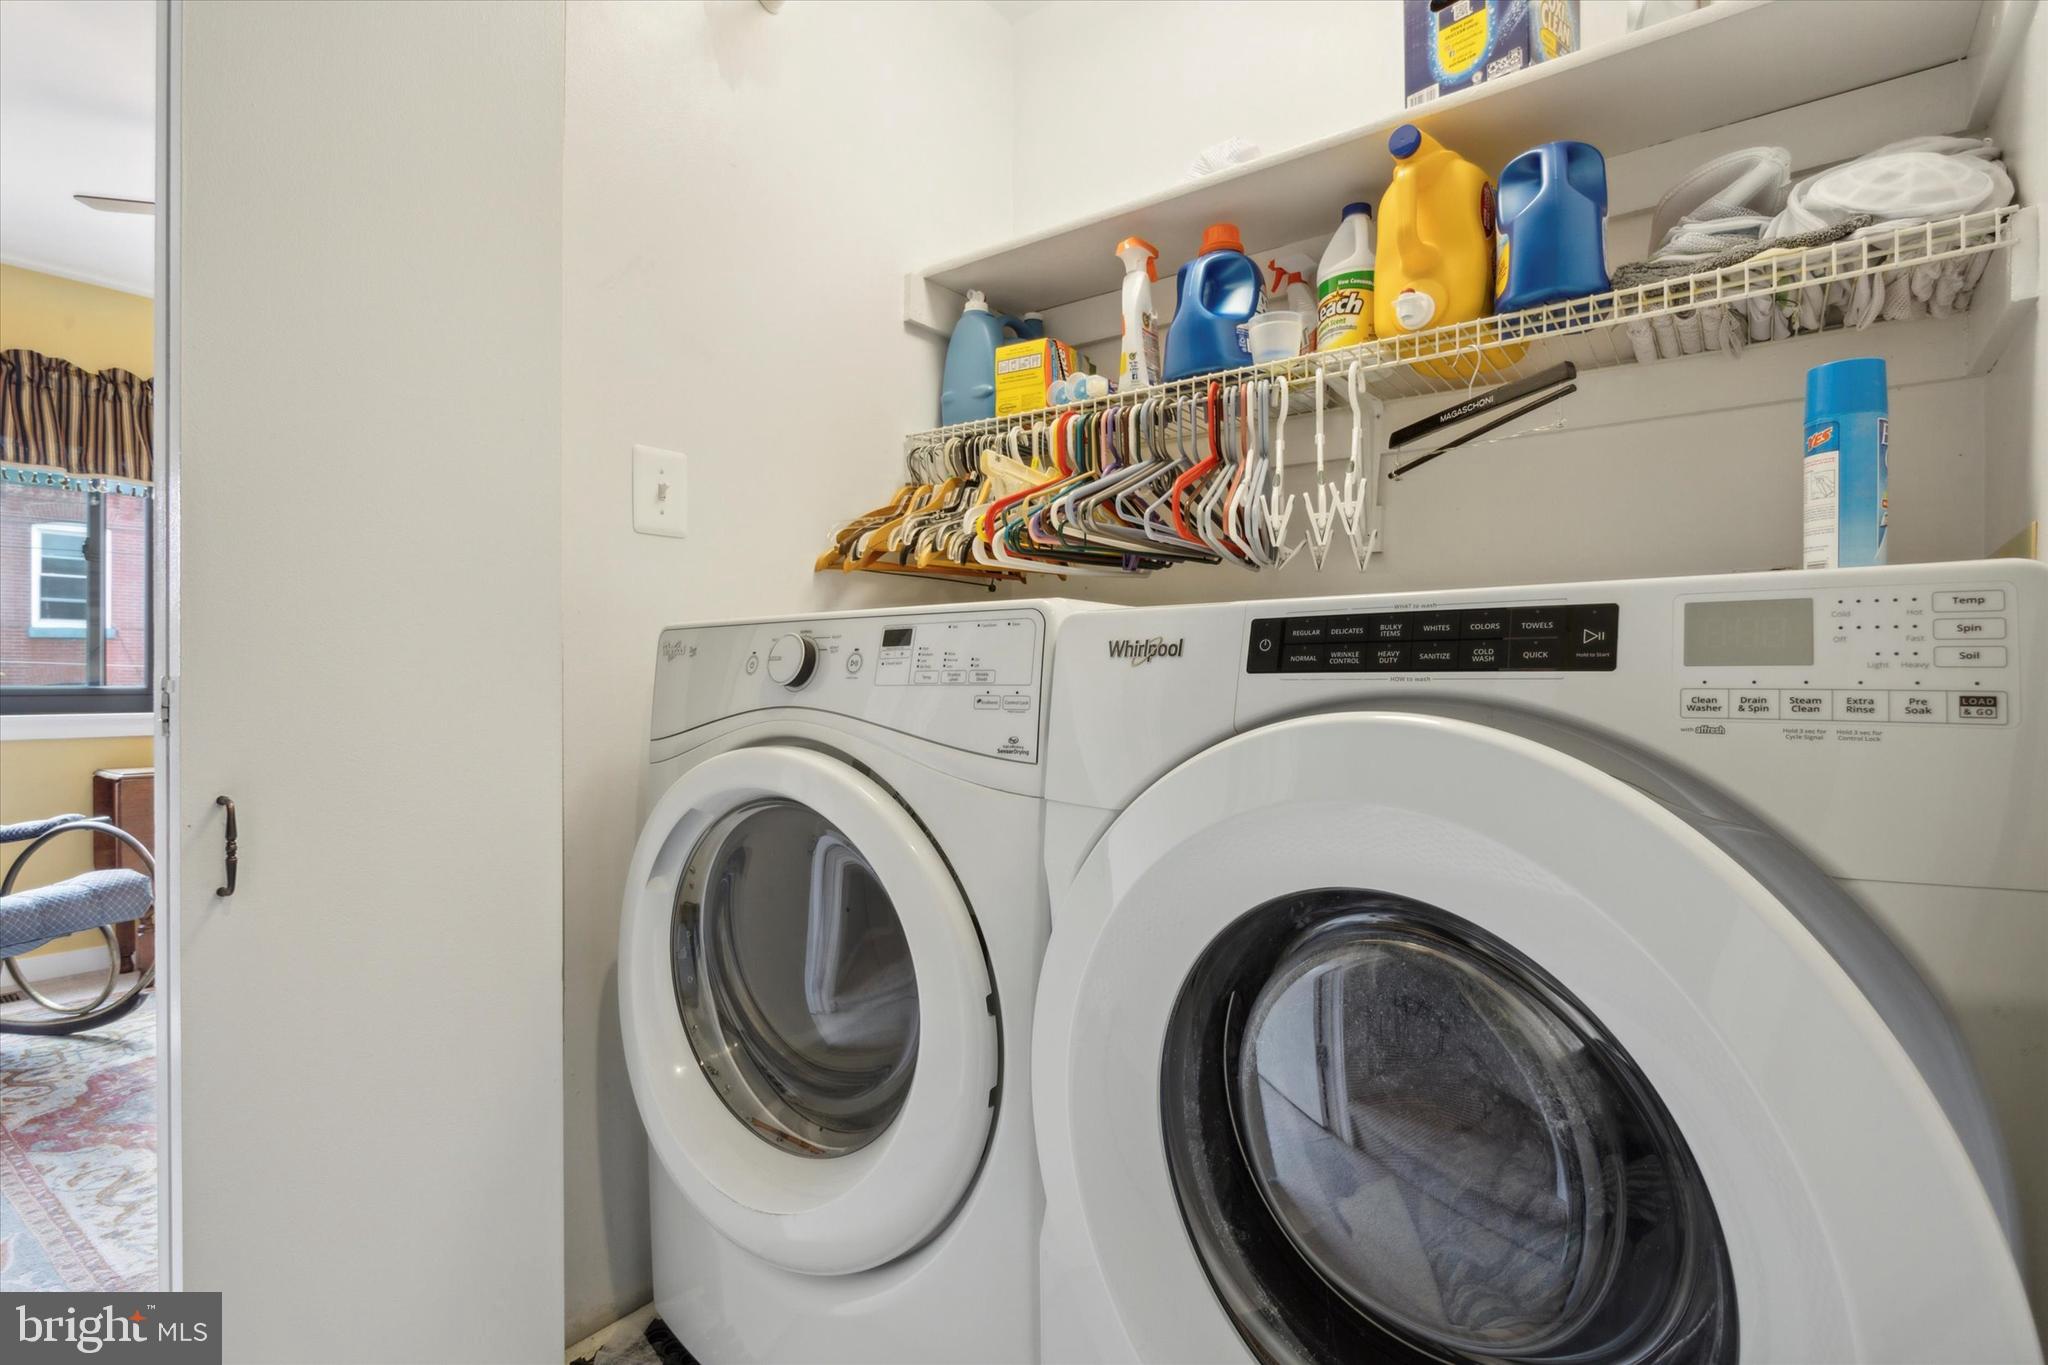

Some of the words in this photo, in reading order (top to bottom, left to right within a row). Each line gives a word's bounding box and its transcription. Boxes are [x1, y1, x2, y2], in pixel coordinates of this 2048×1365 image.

[1440, 395, 1494, 423] MAGASCHONI
[1807, 426, 1833, 451] YES
[1953, 596, 1986, 605] Temp
[1423, 624, 1450, 632] WHITES
[1470, 622, 1500, 630] COLORS
[1521, 621, 1554, 629] TOWELS
[1956, 623, 1982, 633] Spin
[1292, 629, 1320, 637] REGULAR
[1331, 627, 1364, 635] DELICATES
[1108, 637, 1184, 664] Whirlpool
[1419, 652, 1451, 660] SANITIZE
[1523, 651, 1549, 660] QUICK
[1959, 651, 1980, 660] Soil
[1901, 661, 1930, 670] Heavy
[1691, 696, 1718, 704] Clean
[1740, 696, 1767, 704] Drain
[1789, 696, 1822, 705] Steam
[1846, 697, 1875, 705] Extra
[1908, 697, 1928, 706] Pre
[1961, 697, 1995, 706] LOAD
[1686, 704, 1723, 712] Washer
[1737, 704, 1745, 712] &
[1747, 704, 1770, 714] Spin
[1791, 705, 1820, 713] Clean
[1846, 706, 1876, 714] Rinse
[1905, 706, 1933, 715] Soak
[1963, 708, 1971, 716] &
[1976, 708, 1994, 716] GO
